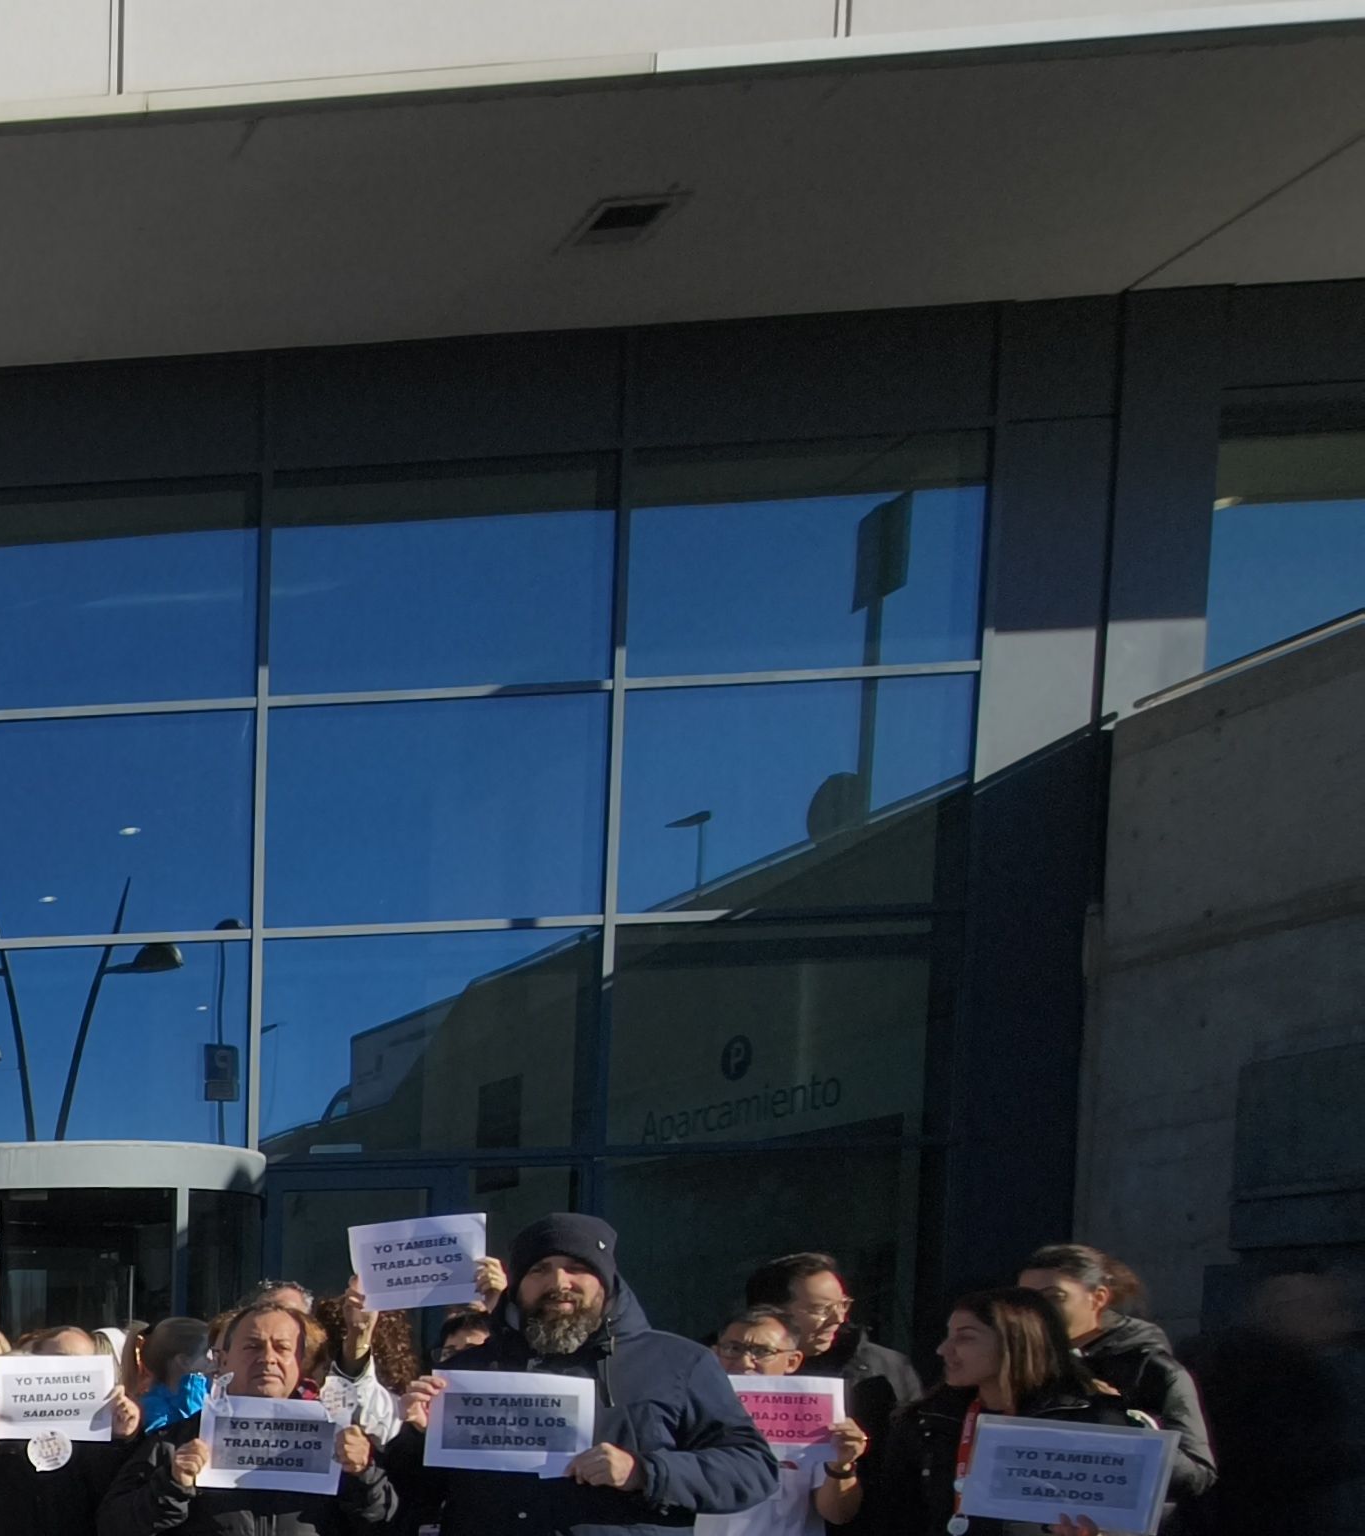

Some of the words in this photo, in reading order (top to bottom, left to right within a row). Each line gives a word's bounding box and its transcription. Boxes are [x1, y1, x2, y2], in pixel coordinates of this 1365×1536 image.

[642, 1073, 841, 1145] Aparcamiento
[374, 1244, 393, 1254] YO
[396, 1236, 458, 1251] TAMBIÉN
[371, 1256, 432, 1272] TRABAJO
[435, 1253, 463, 1264] LOS
[15, 1377, 32, 1386] YO
[36, 1374, 91, 1385] TAMBIÉN
[12, 1392, 68, 1404] TRABAJO
[72, 1391, 96, 1401] LOS
[461, 1397, 483, 1407] YO
[489, 1396, 562, 1408] TAMBIÉN
[454, 1415, 529, 1426] TRABAJO
[534, 1417, 566, 1427] LOS
[751, 1411, 789, 1421] BAJO
[794, 1413, 823, 1422] LOS
[230, 1420, 250, 1430] YO
[471, 1434, 547, 1446] SÁBADOS
[763, 1430, 805, 1438] ADOS
[223, 1437, 289, 1449] TRABAJO
[294, 1440, 323, 1450] LOS
[1015, 1450, 1038, 1460] YO
[1044, 1451, 1124, 1467] TAMBIÉN
[1006, 1467, 1087, 1482] TRABAJO
[1092, 1473, 1128, 1486] LOS
[1021, 1486, 1105, 1502] SÁBADOS
